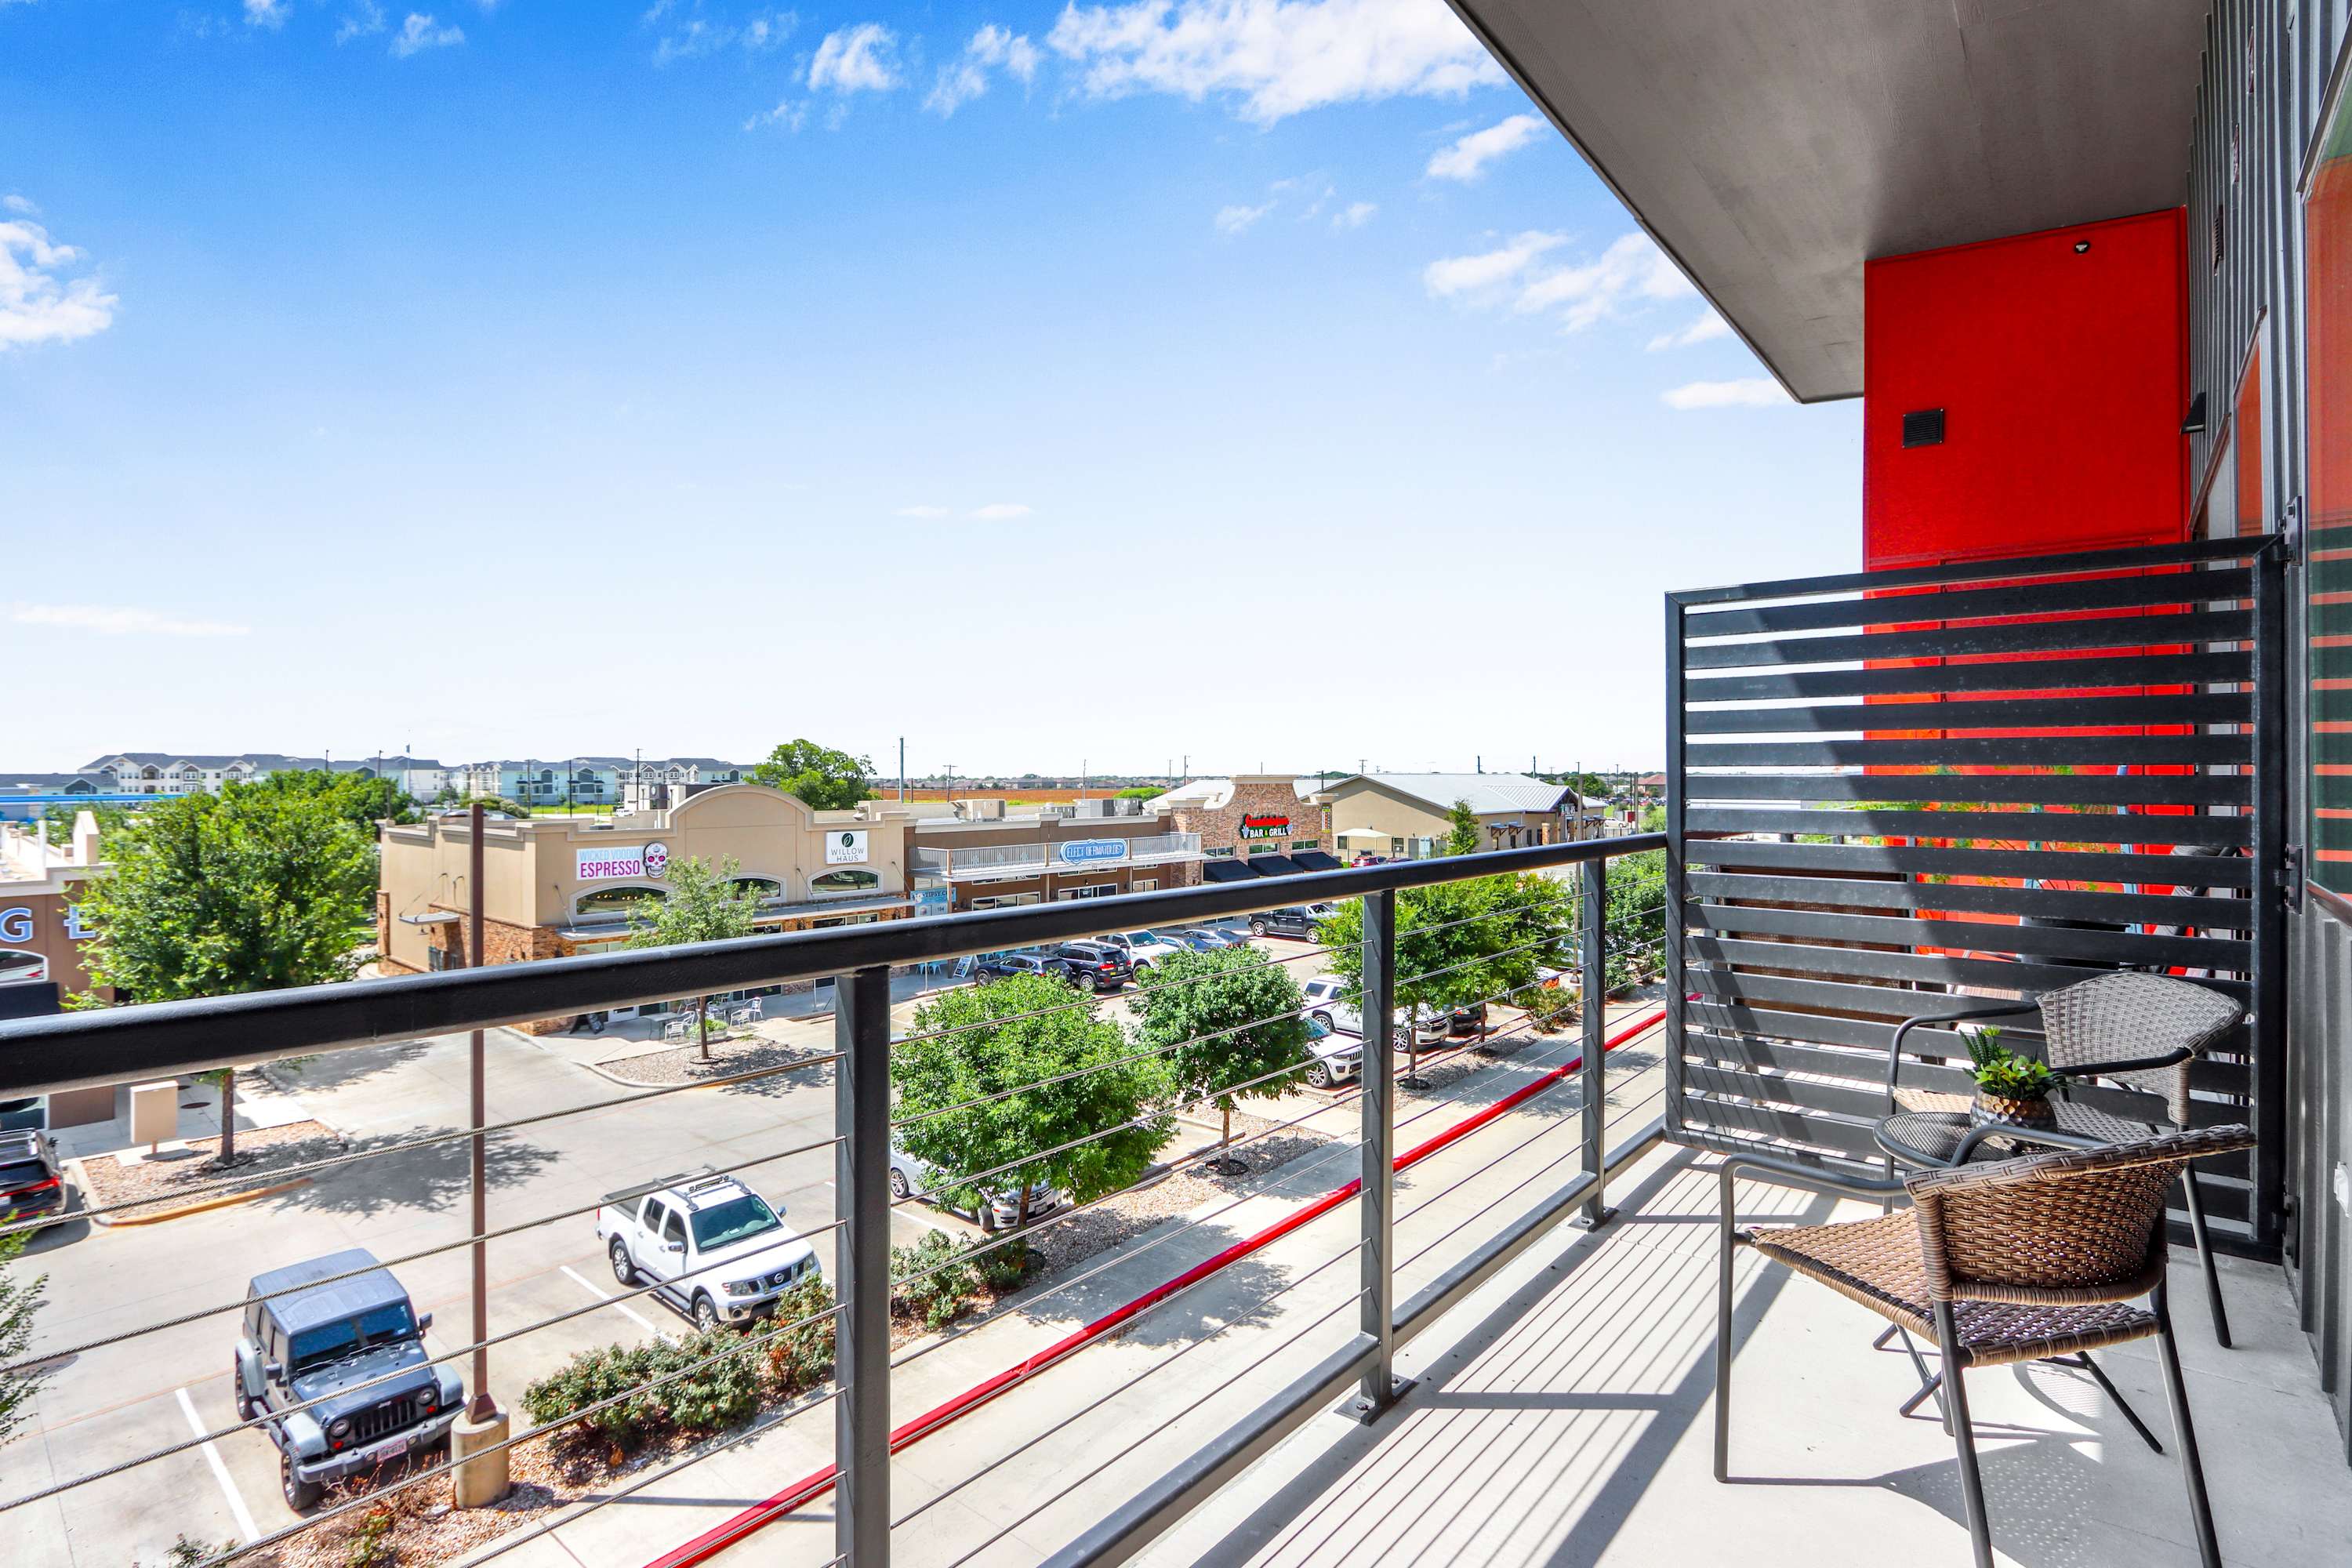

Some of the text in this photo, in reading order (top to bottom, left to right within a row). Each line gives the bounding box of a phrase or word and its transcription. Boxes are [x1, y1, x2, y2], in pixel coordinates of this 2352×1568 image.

[1250, 829, 1264, 838] BAR
[1269, 827, 1287, 837] GRILL
[579, 850, 609, 862] WICKED
[831, 847, 864, 855] WILLOW
[580, 860, 641, 878] ESPRESSO
